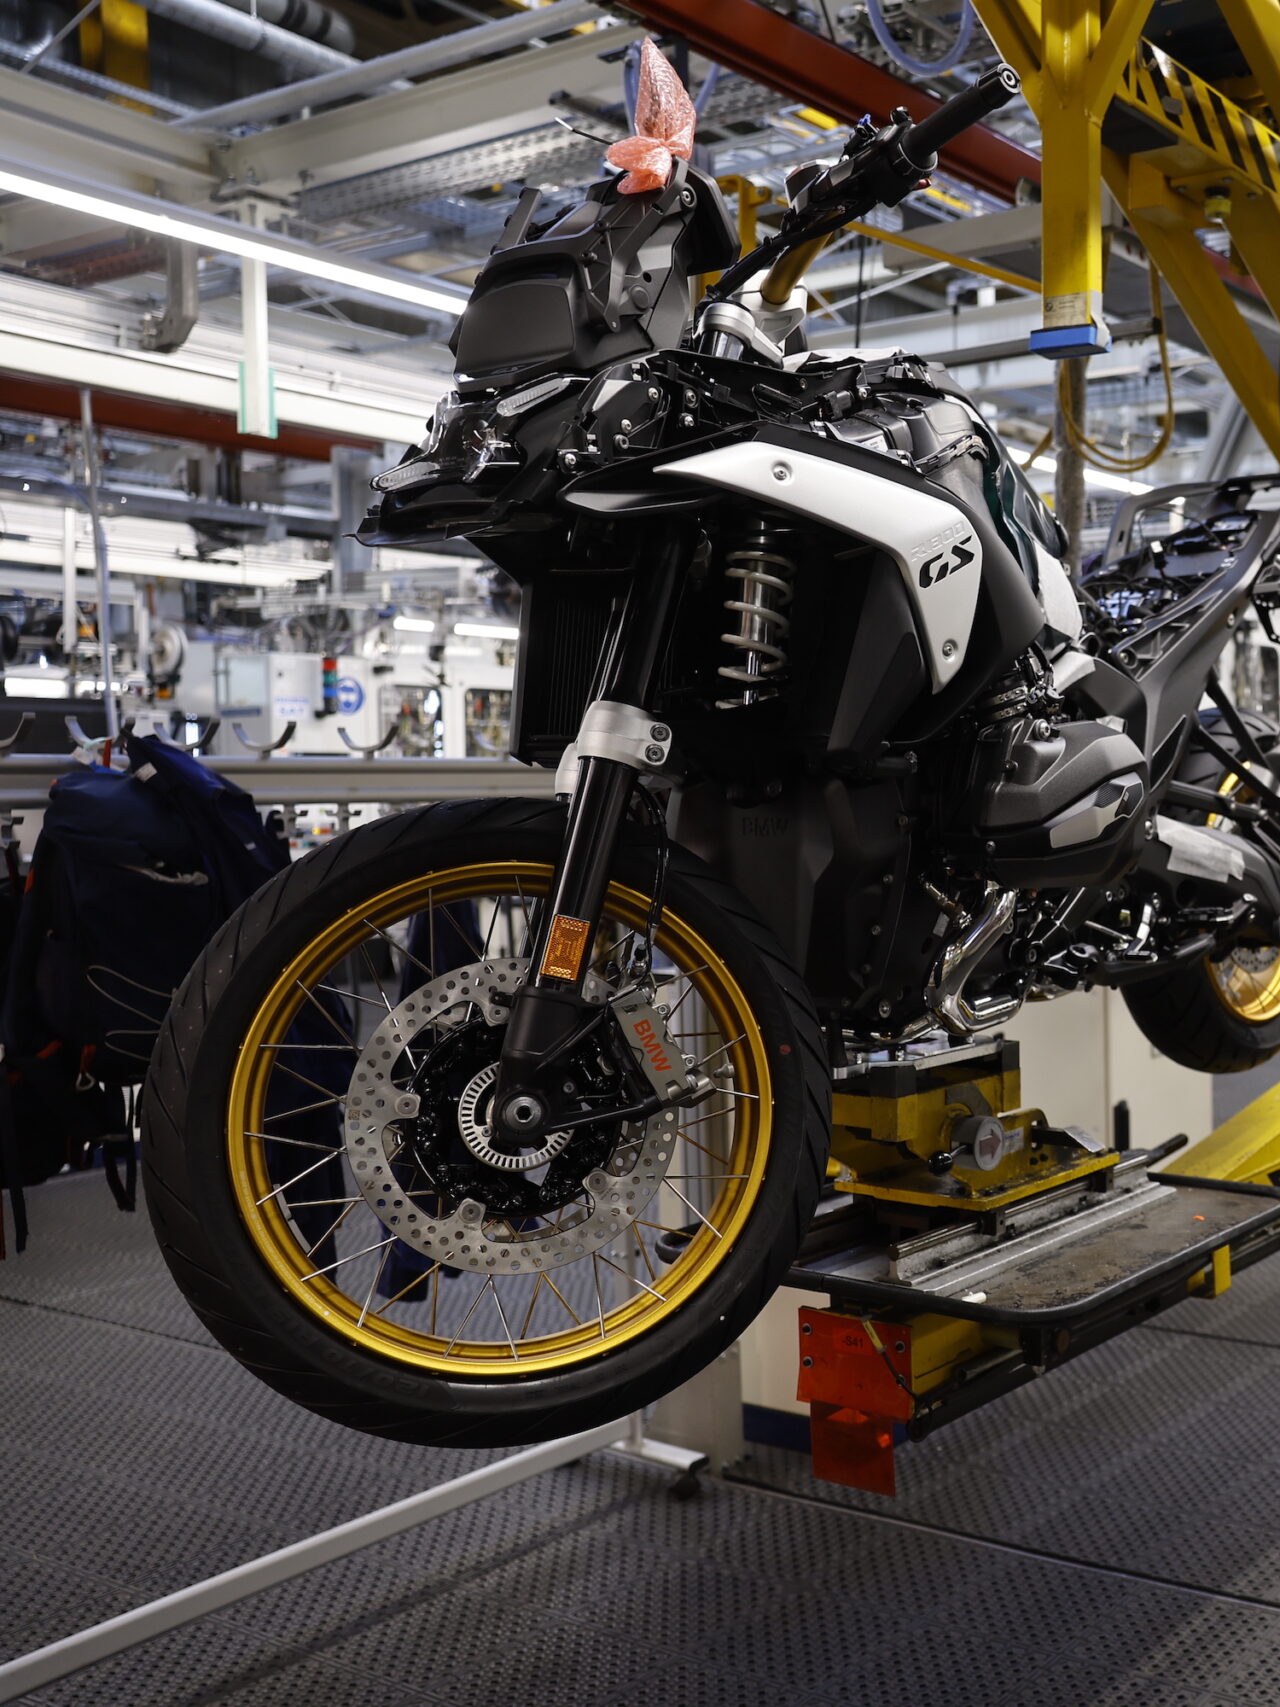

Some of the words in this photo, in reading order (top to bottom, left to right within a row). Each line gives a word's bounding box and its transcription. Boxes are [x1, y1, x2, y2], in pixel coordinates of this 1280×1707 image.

[918, 535, 975, 589] GS
[741, 816, 791, 836] BMW
[633, 1019, 672, 1071] BMW
